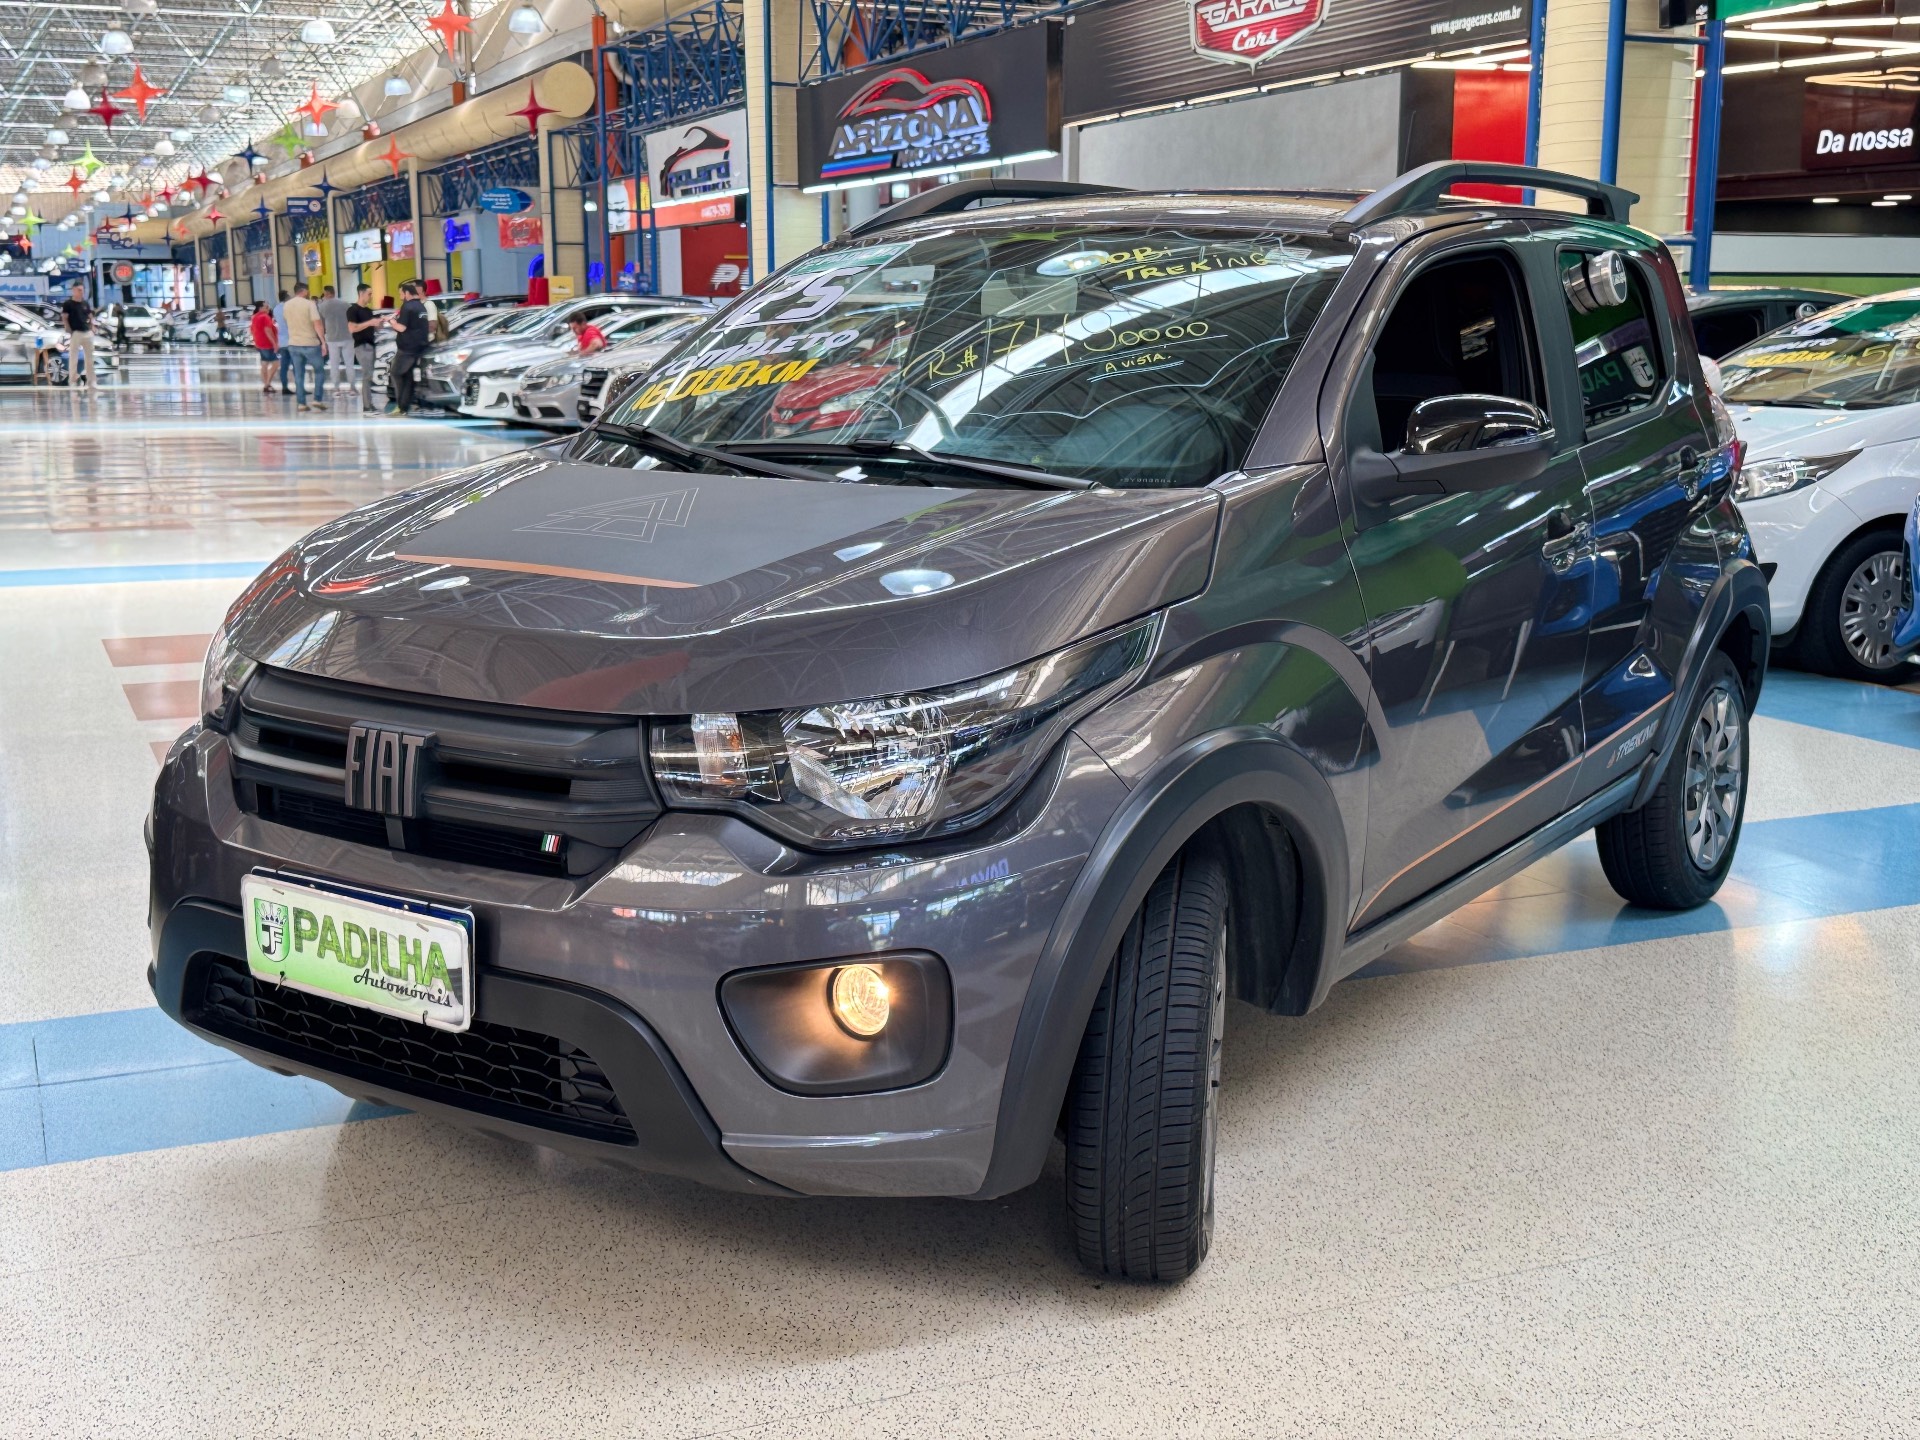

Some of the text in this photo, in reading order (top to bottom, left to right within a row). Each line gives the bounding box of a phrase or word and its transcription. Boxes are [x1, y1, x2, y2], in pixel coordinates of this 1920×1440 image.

[1197, 0, 1311, 25] GARA
[1430, 5, 1523, 35] www.garagecars.com.br
[1232, 28, 1280, 52] Cars
[828, 97, 988, 159] ARIZONA
[1816, 127, 1914, 155] Da nossa
[648, 329, 860, 382] COMPLETO
[1105, 362, 1118, 373] A
[631, 358, 821, 412] 16000KM
[344, 724, 425, 817] FIAT
[292, 906, 454, 992] PADILHA
[353, 968, 453, 1008] Automóveis
